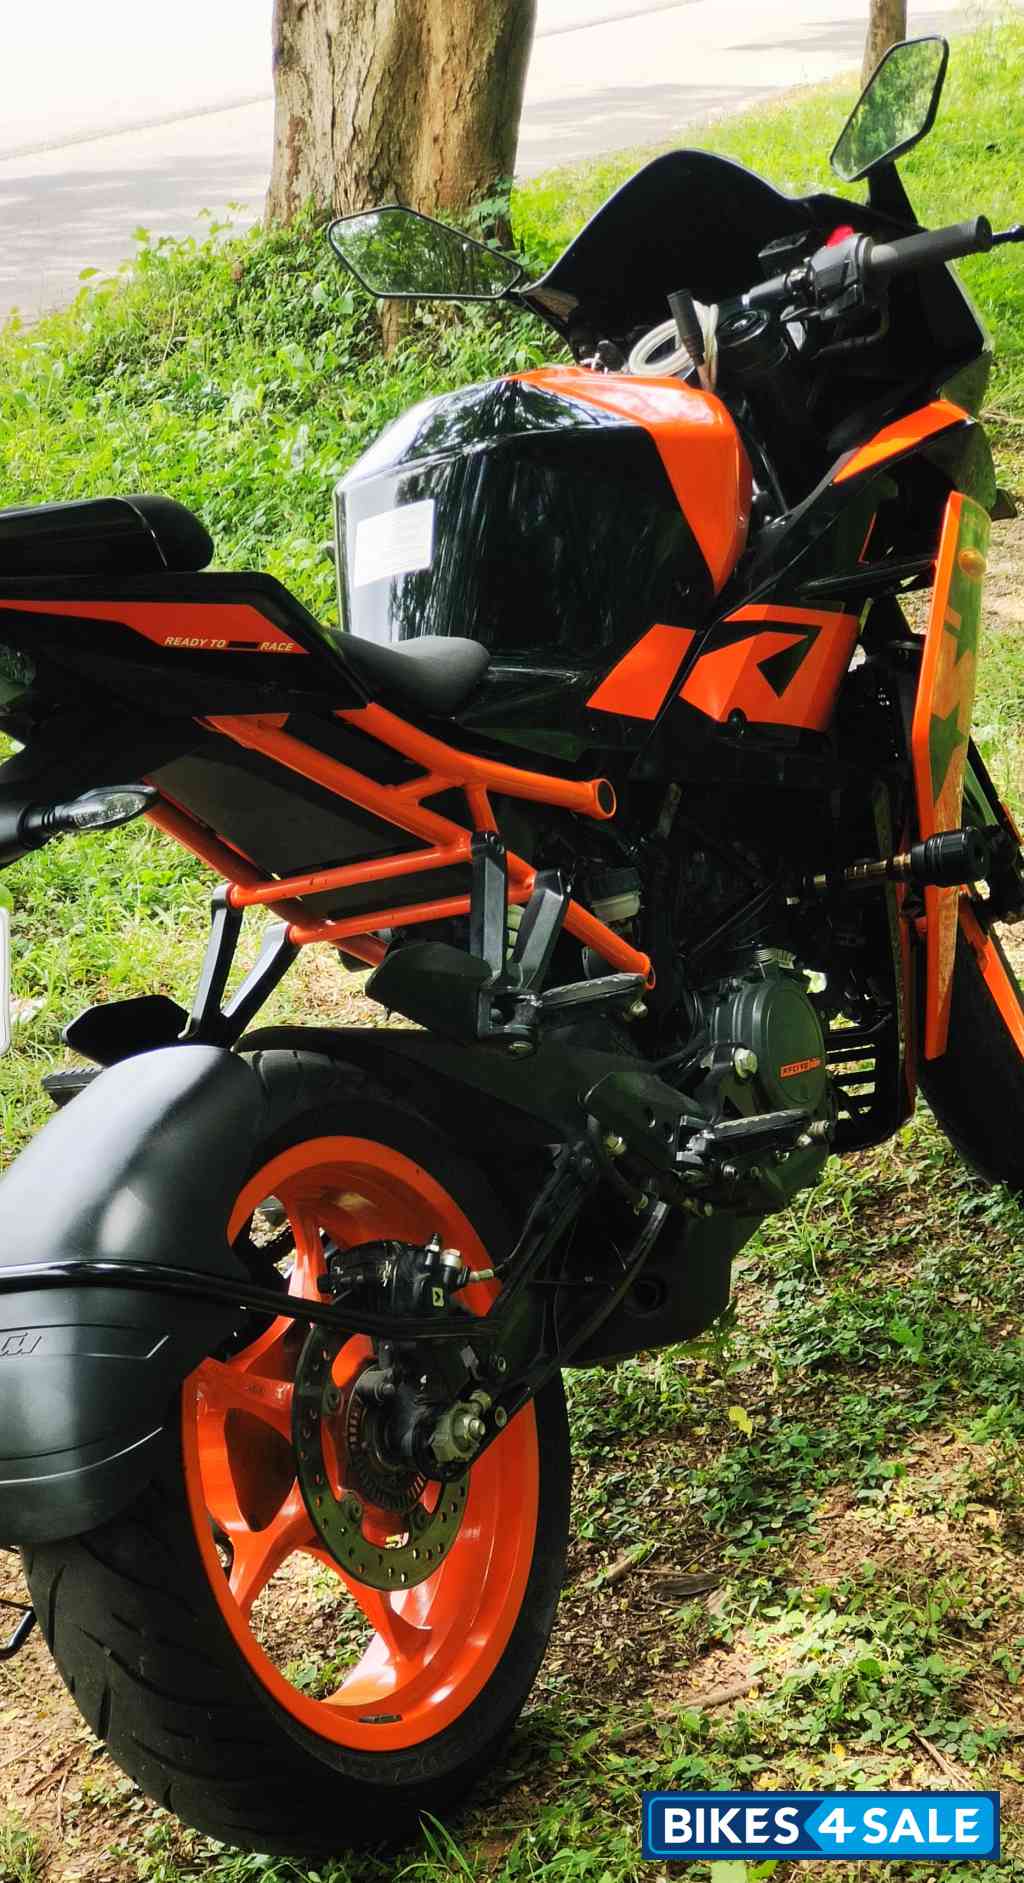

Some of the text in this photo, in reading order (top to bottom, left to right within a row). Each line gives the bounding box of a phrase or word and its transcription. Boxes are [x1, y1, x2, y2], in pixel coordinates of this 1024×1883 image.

[164, 636, 294, 651] READY TO RACE
